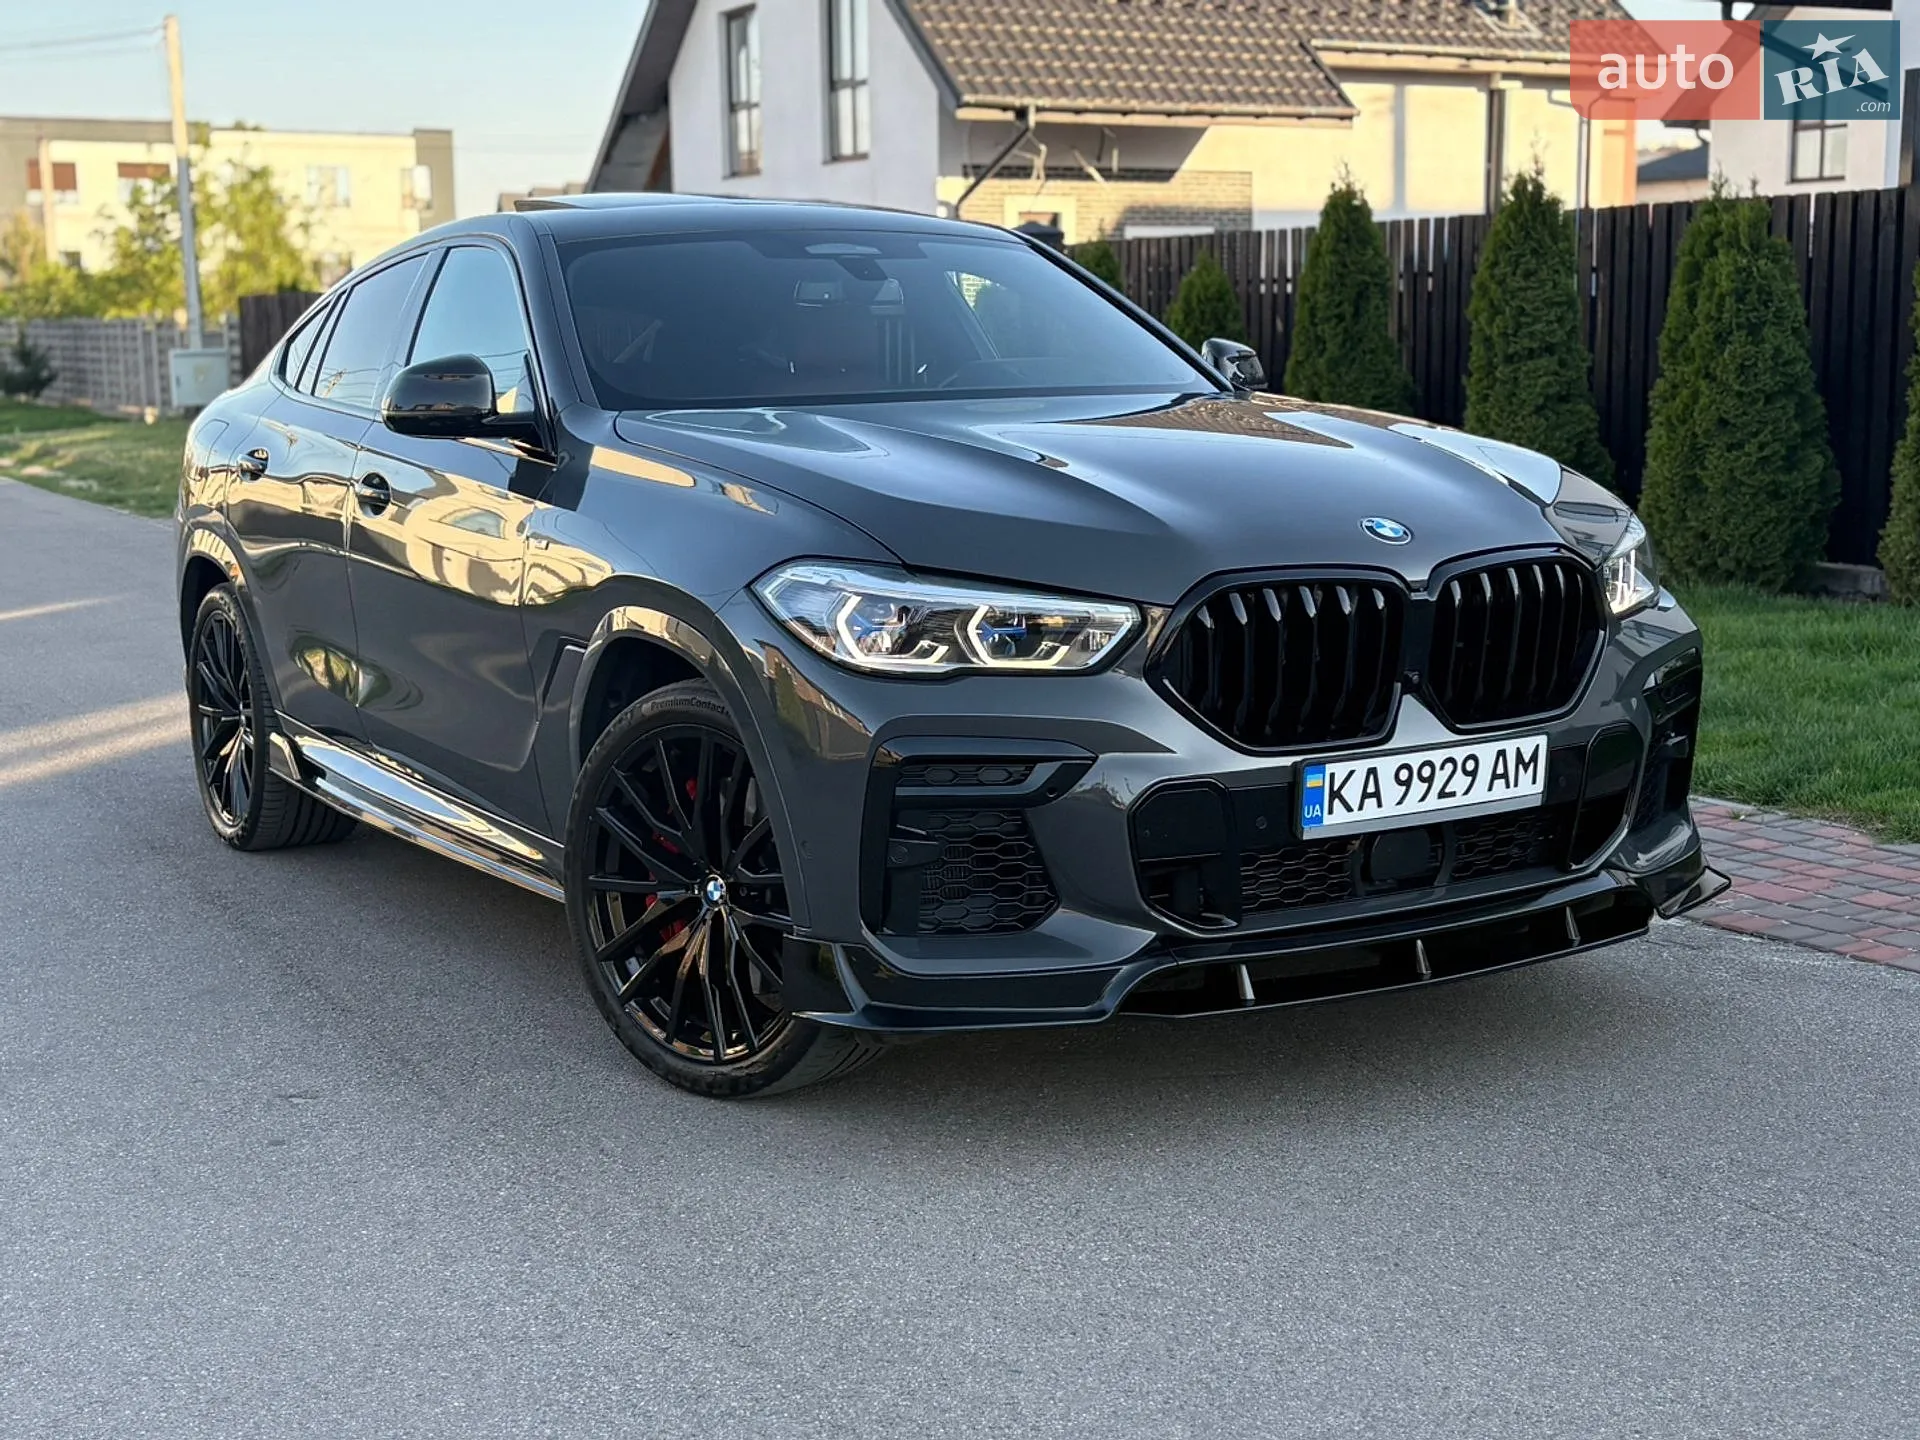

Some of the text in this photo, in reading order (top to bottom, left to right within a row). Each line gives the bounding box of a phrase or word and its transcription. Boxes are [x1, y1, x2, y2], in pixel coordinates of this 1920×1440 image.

[1327, 743, 1540, 815] KA 9929 AM
[1304, 804, 1322, 819] UA
